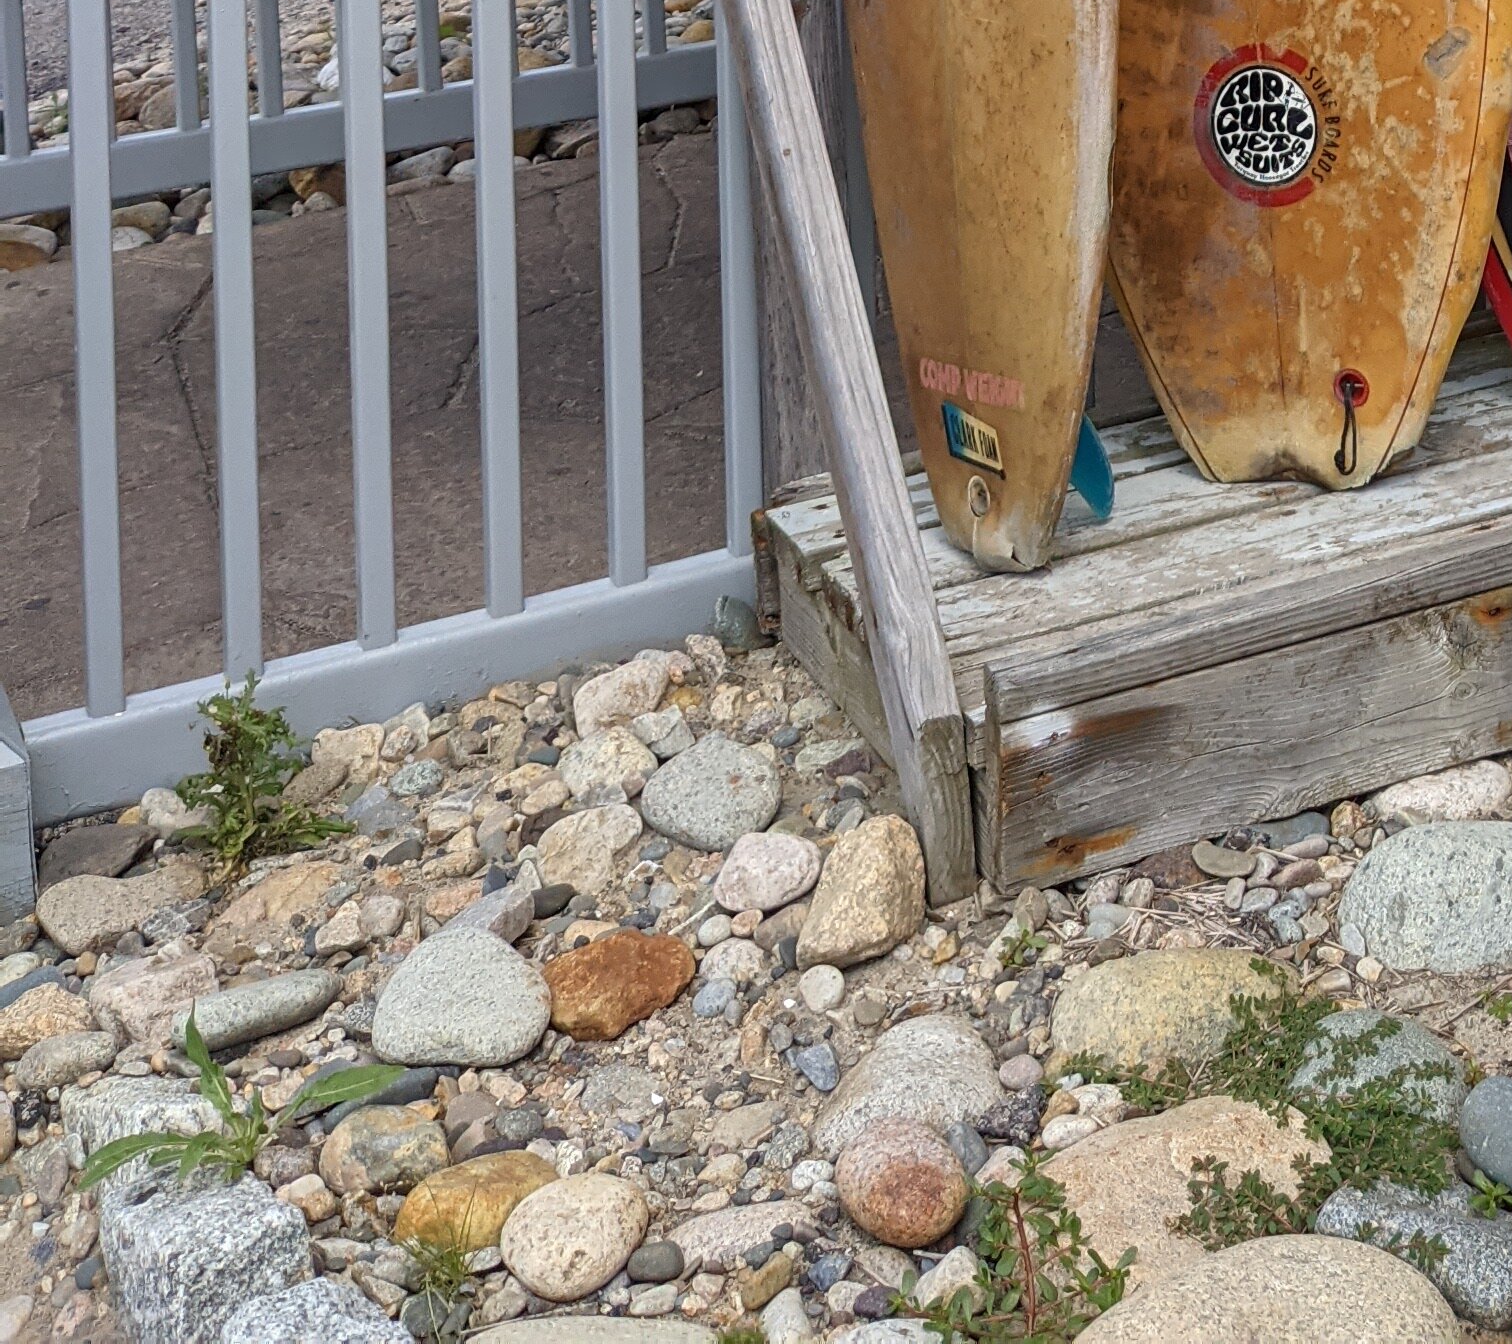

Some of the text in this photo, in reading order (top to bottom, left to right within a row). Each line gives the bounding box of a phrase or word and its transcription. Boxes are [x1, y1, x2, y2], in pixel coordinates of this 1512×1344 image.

[1219, 70, 1284, 108] RIP
[1216, 103, 1314, 141] CURL
[1304, 66, 1341, 184] SURF BOARDS
[919, 357, 961, 397] COMP
[949, 413, 1000, 464] CLARK FOAM
